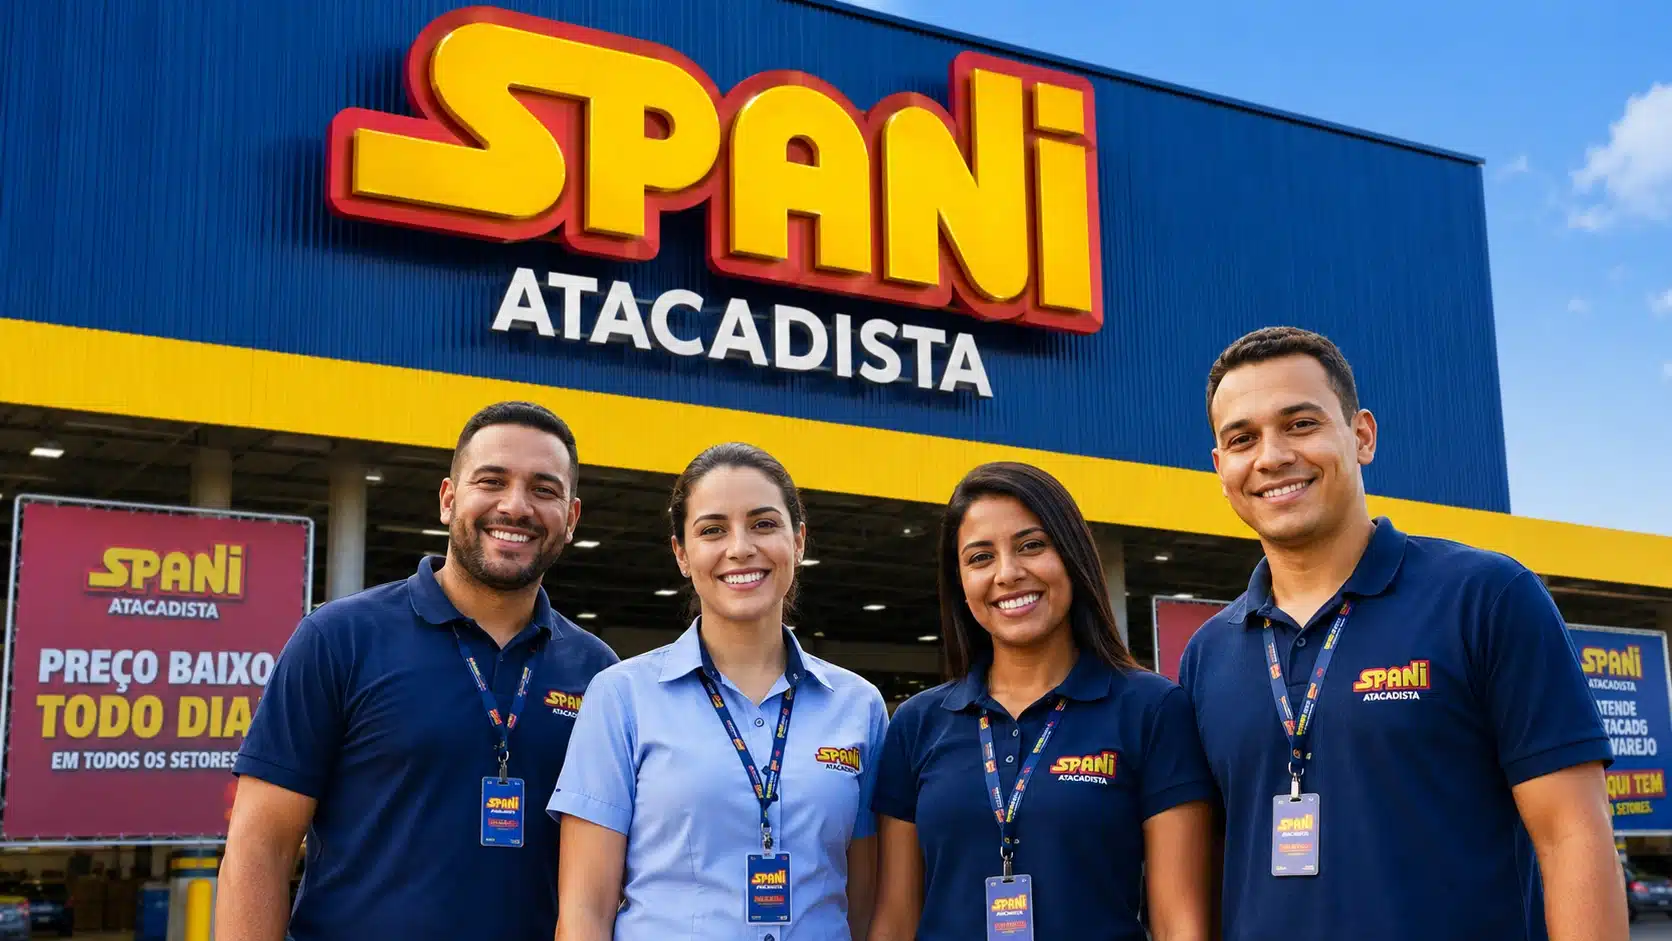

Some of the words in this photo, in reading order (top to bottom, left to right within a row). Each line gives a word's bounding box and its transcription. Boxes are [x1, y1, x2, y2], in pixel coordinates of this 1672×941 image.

[491, 266, 994, 398] ATACADISTA
[108, 598, 219, 619] ATACADISTA
[38, 648, 159, 693] PREÇO
[168, 651, 275, 686] BAIXO
[1363, 691, 1420, 702] ATACADISTA
[36, 694, 164, 739] TODO
[51, 751, 80, 770] EM
[83, 751, 140, 770] TODOS
[143, 751, 167, 769] OS
[1058, 774, 1108, 786] ATACADISTA
